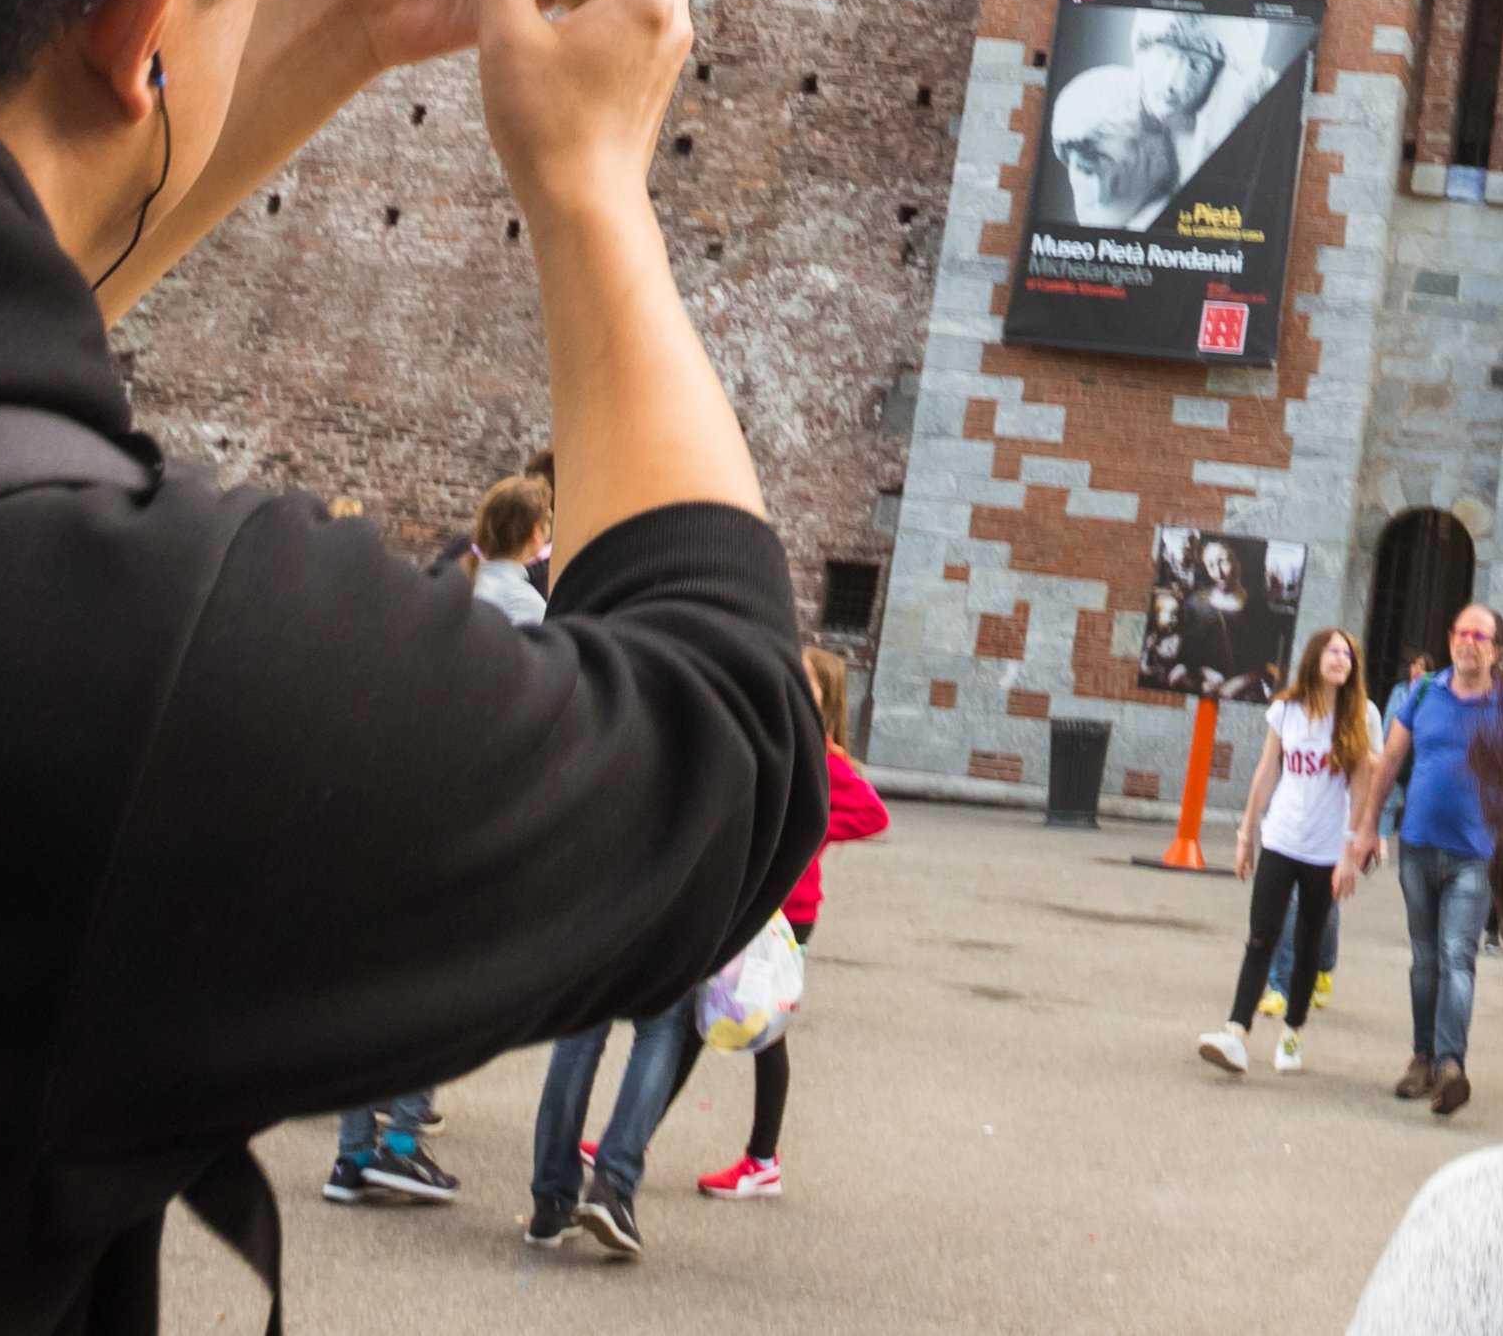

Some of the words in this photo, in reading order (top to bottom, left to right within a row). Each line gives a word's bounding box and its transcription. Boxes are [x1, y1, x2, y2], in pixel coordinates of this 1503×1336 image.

[1193, 202, 1242, 228] Pietà
[1030, 233, 1096, 261] Museo
[1098, 238, 1146, 266] Pietà
[1147, 243, 1244, 274] Rondanini
[1028, 255, 1153, 287] Michelangelo
